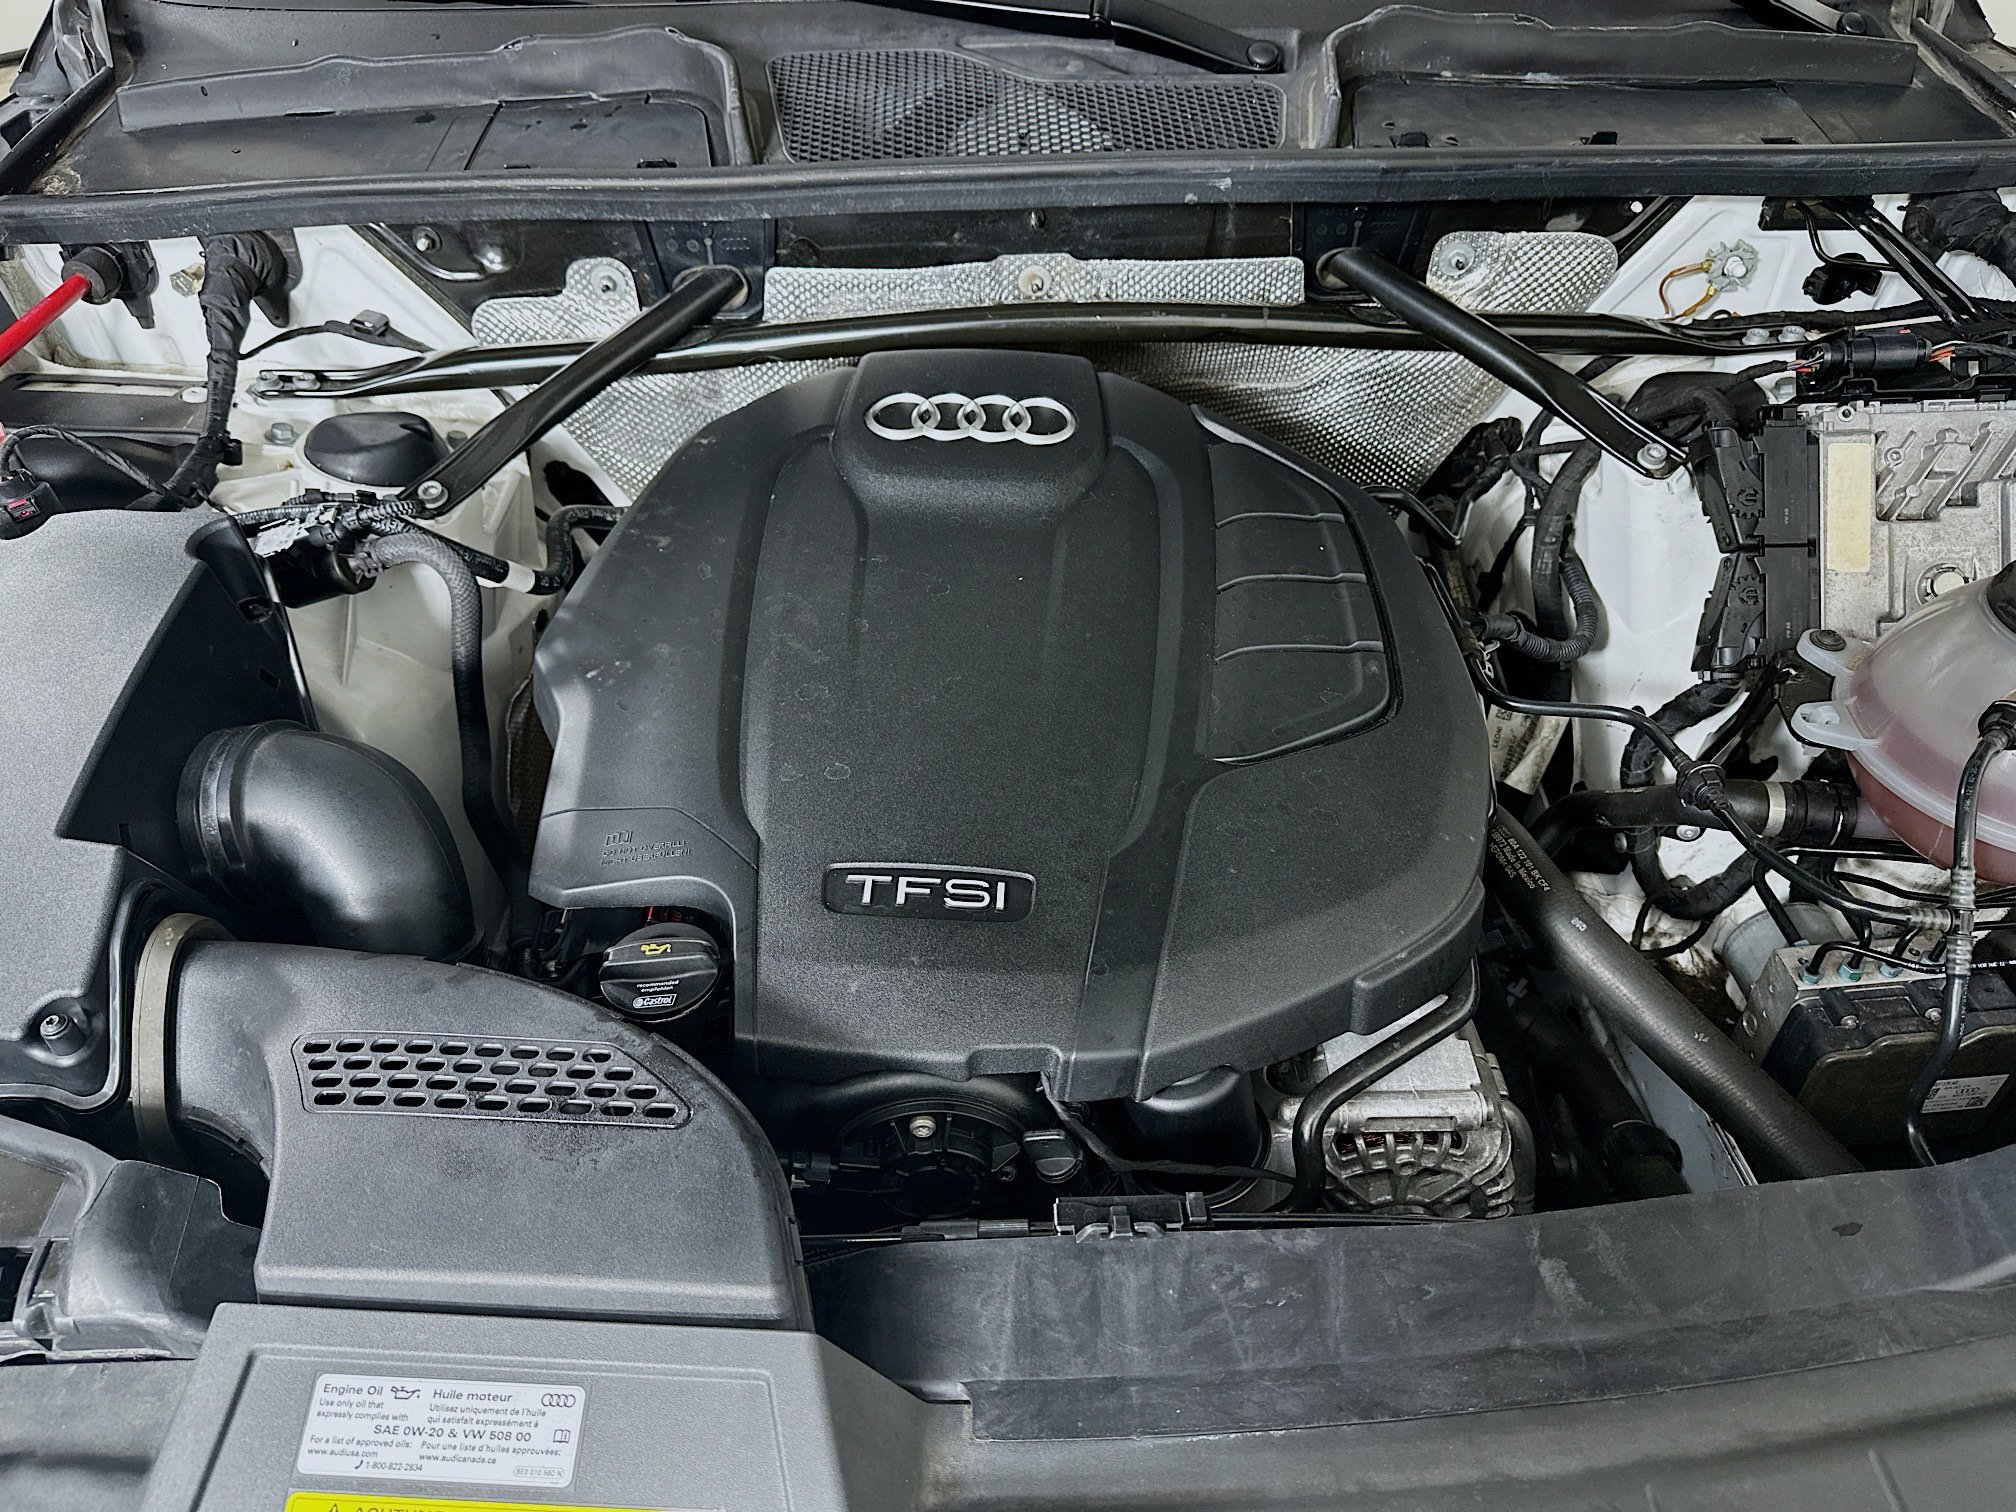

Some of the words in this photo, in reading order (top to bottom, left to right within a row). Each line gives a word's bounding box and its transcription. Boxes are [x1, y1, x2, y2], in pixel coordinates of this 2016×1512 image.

[620, 846, 638, 854] NOT
[1516, 849, 1527, 859] 122
[1503, 846, 1516, 862] Made
[1513, 861, 1520, 870] in
[1518, 868, 1535, 888] Mexico
[845, 874, 1006, 913] TFSI
[637, 980, 679, 988] recommended
[643, 996, 672, 1006] Castrol
[323, 1384, 363, 1396] Engine
[367, 1386, 384, 1396] Oil
[433, 1389, 463, 1400] Huile
[466, 1392, 512, 1402] moteur
[319, 1398, 334, 1406] Use
[336, 1399, 354, 1408] only
[356, 1400, 366, 1408] oil
[368, 1400, 384, 1408] that
[316, 1410, 354, 1419] expressly
[355, 1412, 390, 1420] complies
[392, 1413, 408, 1421] with
[429, 1404, 458, 1412] Utilisez
[460, 1406, 508, 1416] uniquement
[510, 1408, 520, 1416] de
[427, 1416, 440, 1424] qui
[442, 1416, 474, 1424] satisfait
[476, 1418, 532, 1428] expressément
[374, 1424, 400, 1436] SAE
[403, 1426, 444, 1438] 0W-20
[448, 1428, 458, 1438] &
[463, 1429, 486, 1440] VW
[489, 1430, 512, 1441] 508
[516, 1432, 532, 1442] 00
[310, 1434, 323, 1444] For
[332, 1436, 344, 1444] list
[346, 1437, 355, 1445] of
[356, 1438, 394, 1448] approved
[396, 1440, 412, 1448] oils:
[308, 1448, 378, 1458] www.audiusa.com
[422, 1441, 440, 1450] Pour
[459, 1442, 476, 1452] liste
[512, 1446, 562, 1456] approuvées:
[419, 1454, 497, 1464] www.audicanada.ca
[366, 1461, 422, 1472] 1-800-822-2834
